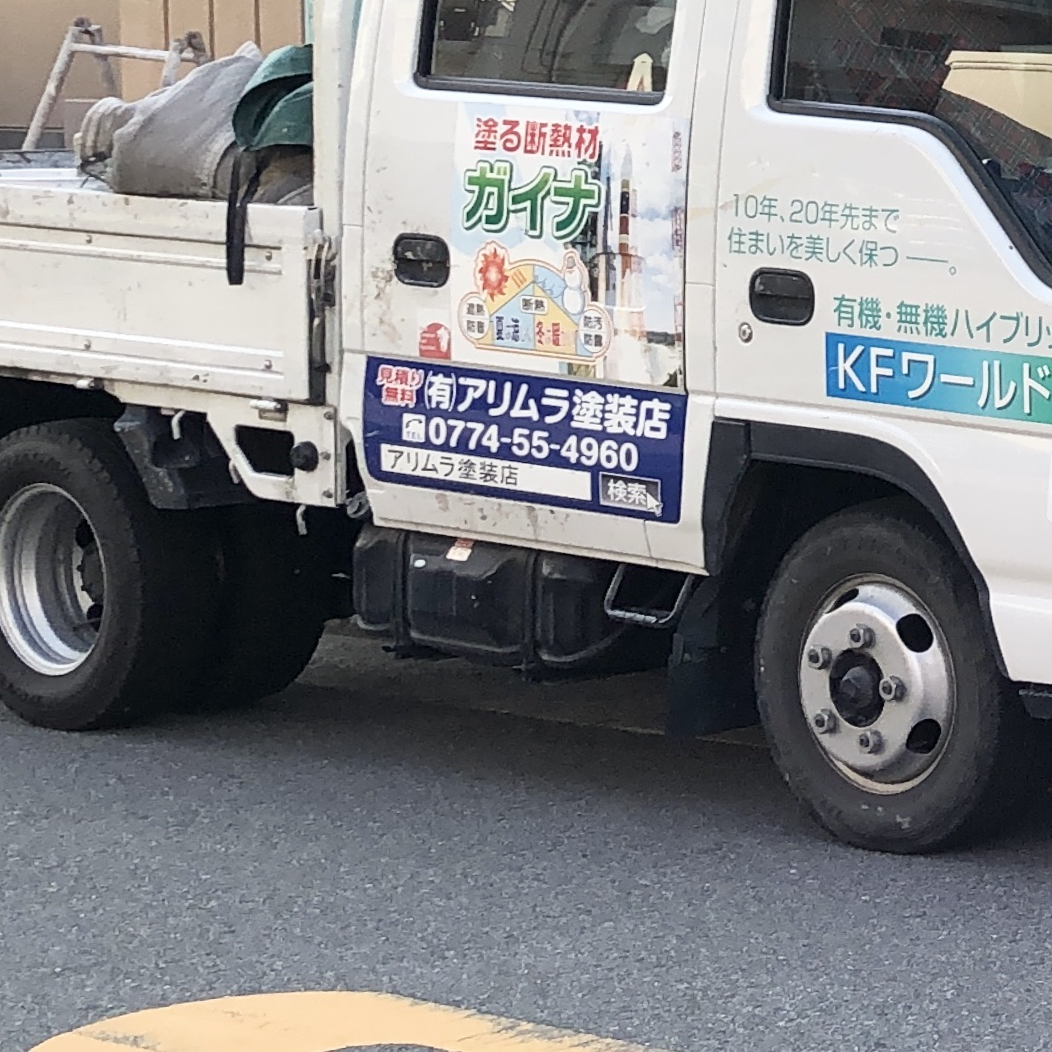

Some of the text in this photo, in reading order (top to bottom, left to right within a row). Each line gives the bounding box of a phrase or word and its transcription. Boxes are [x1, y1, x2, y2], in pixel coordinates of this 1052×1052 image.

[473, 117, 599, 160] 塗る断熱材
[463, 160, 602, 240] ガイナ
[732, 193, 900, 234] 10年、20年先まで
[376, 364, 425, 390] 見積り
[381, 384, 417, 408] 無料
[428, 416, 639, 473] 0774-55-4960
[387, 449, 519, 487] アリムラ塗装店
[607, 478, 648, 506] 検索
